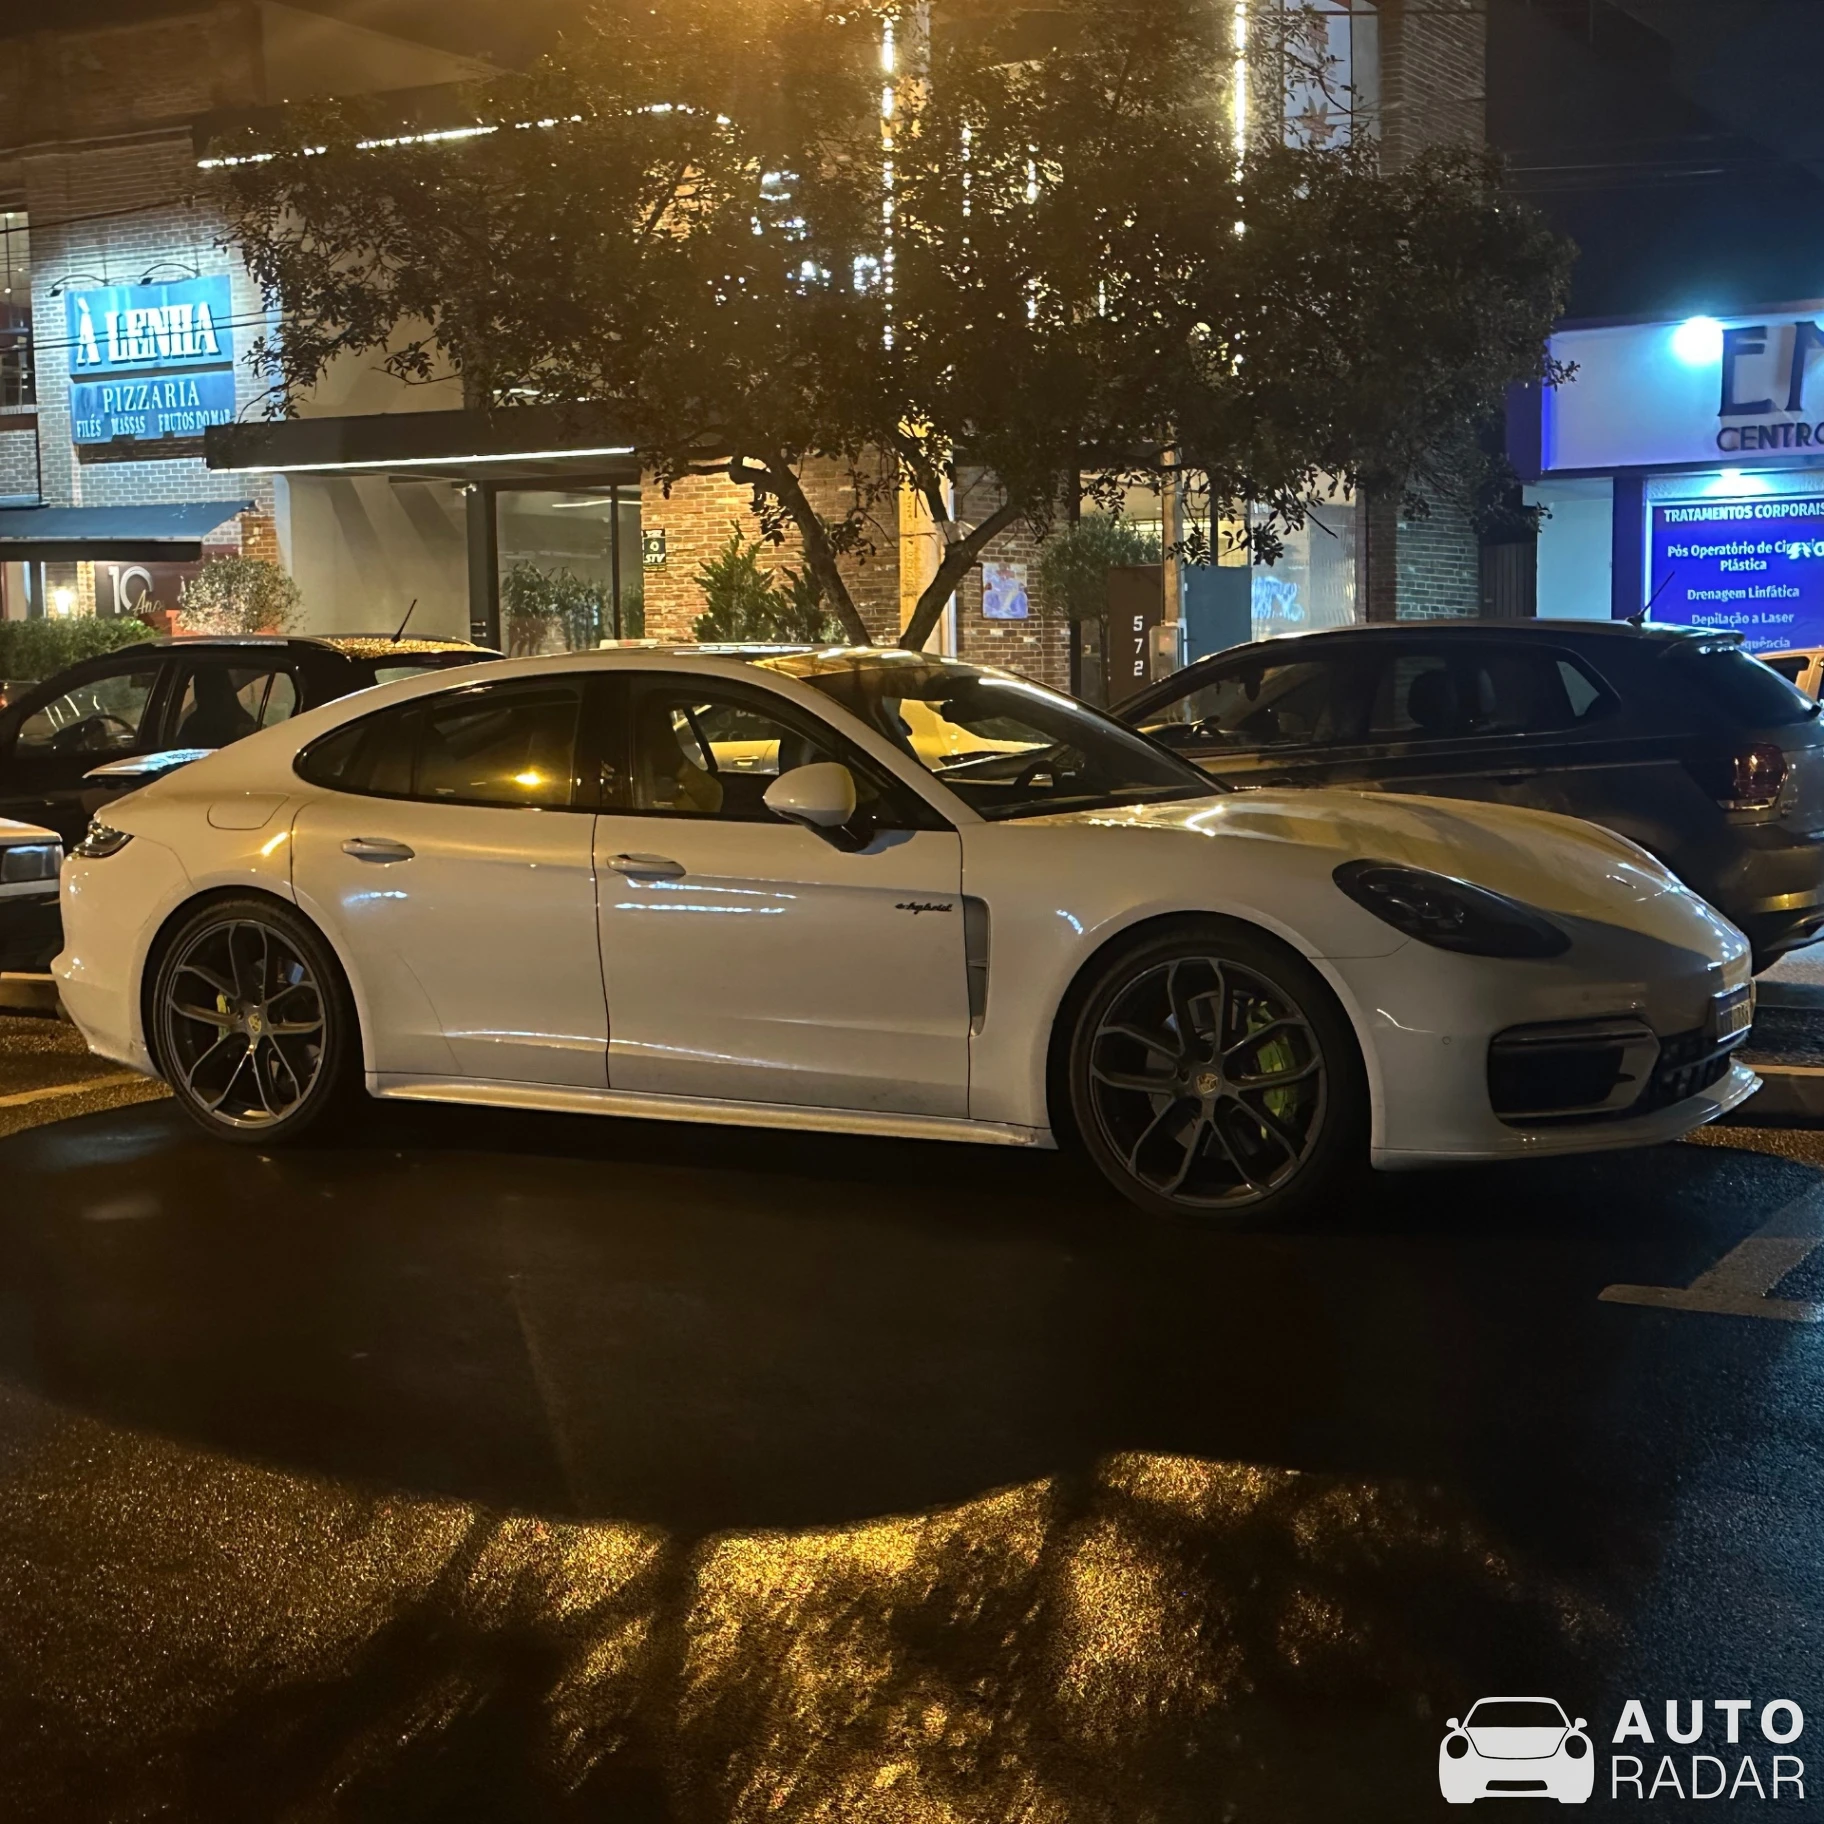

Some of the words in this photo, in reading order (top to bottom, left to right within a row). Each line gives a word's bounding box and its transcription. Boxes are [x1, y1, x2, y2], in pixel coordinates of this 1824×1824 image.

[103, 381, 200, 413] PIZZARIA
[77, 414, 101, 438] FILÉS
[111, 416, 146, 436] MASSAS
[158, 411, 195, 433] FRUTOS
[1664, 505, 1753, 522] TRATAMENTOS
[1668, 544, 1688, 557] Pós
[1691, 541, 1755, 559] Operatório
[1757, 541, 1773, 554] de
[1720, 558, 1768, 572] Plástica
[1687, 588, 1746, 602] Drenagem
[1748, 584, 1800, 599] Linfática
[1691, 611, 1750, 628] Depilação
[1752, 615, 1759, 624] a
[1761, 612, 1795, 624] Laser
[1133, 615, 1144, 677] 572
